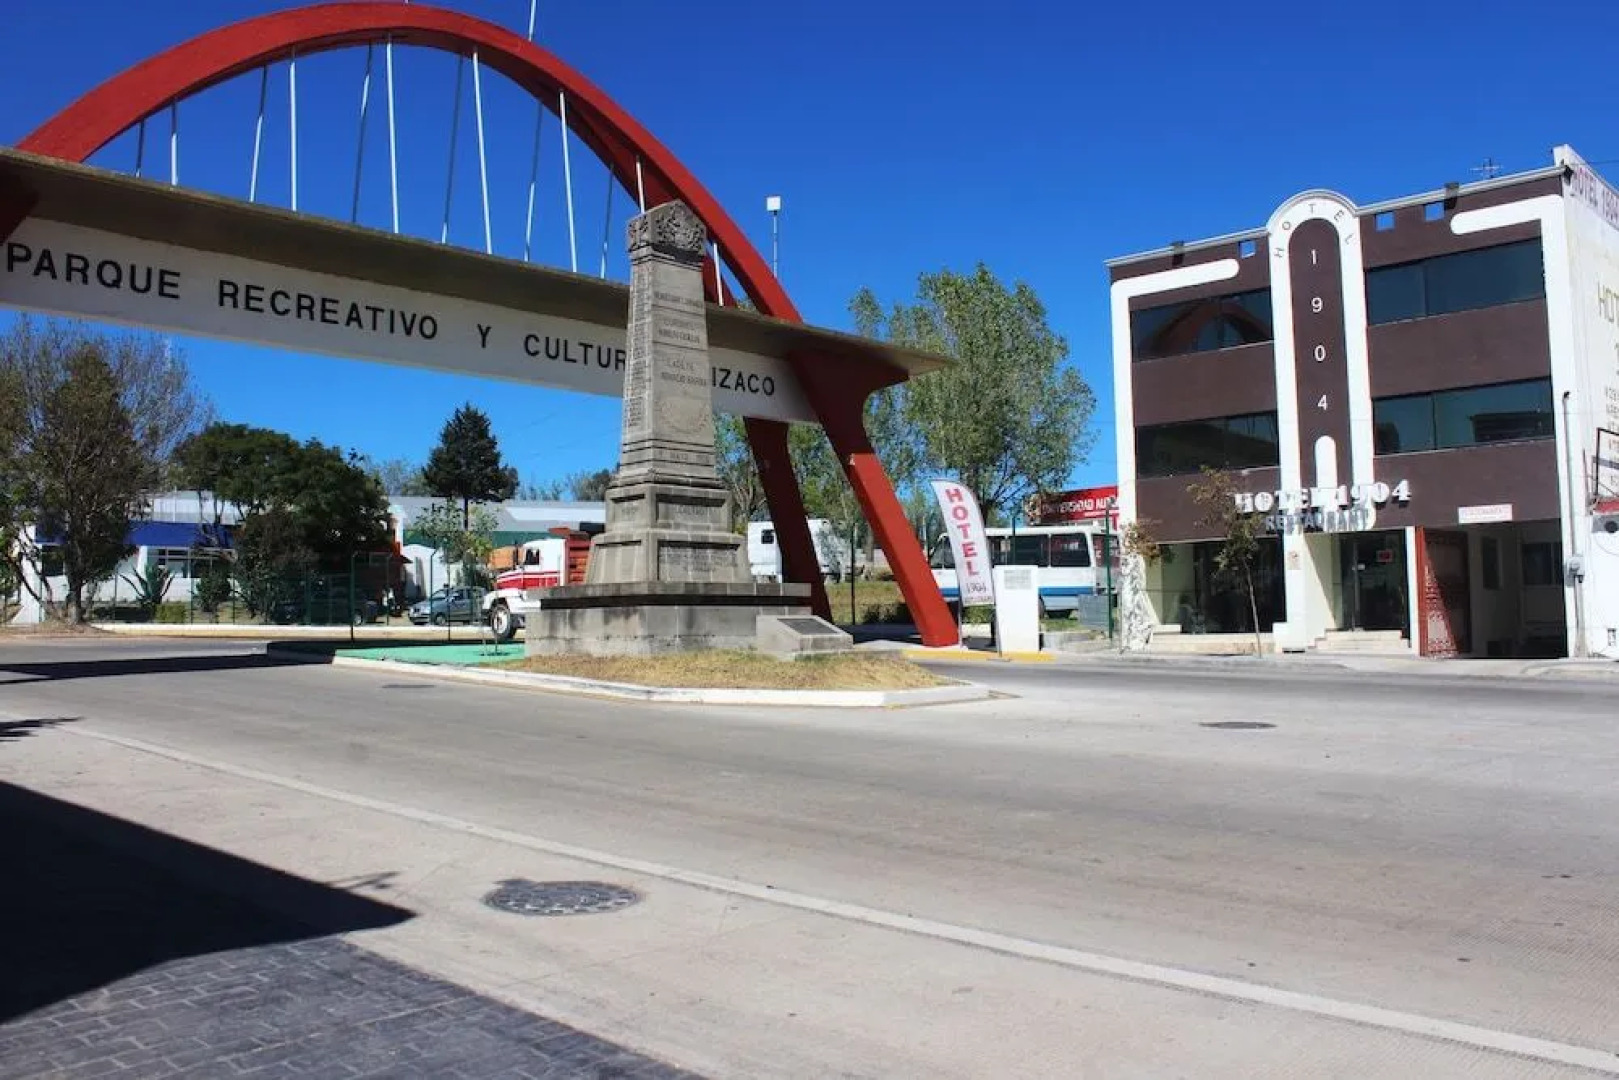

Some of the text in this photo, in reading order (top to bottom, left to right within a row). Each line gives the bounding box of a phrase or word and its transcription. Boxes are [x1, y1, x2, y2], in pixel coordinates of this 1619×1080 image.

[1274, 204, 1355, 258] HOTEL
[7, 242, 775, 396] PARQUE RECREATIVO Y CULTUR IZACO
[1311, 249, 1329, 411] 1904
[945, 488, 979, 577] HOTEL
[1235, 479, 1412, 513] HOTEL 1904
